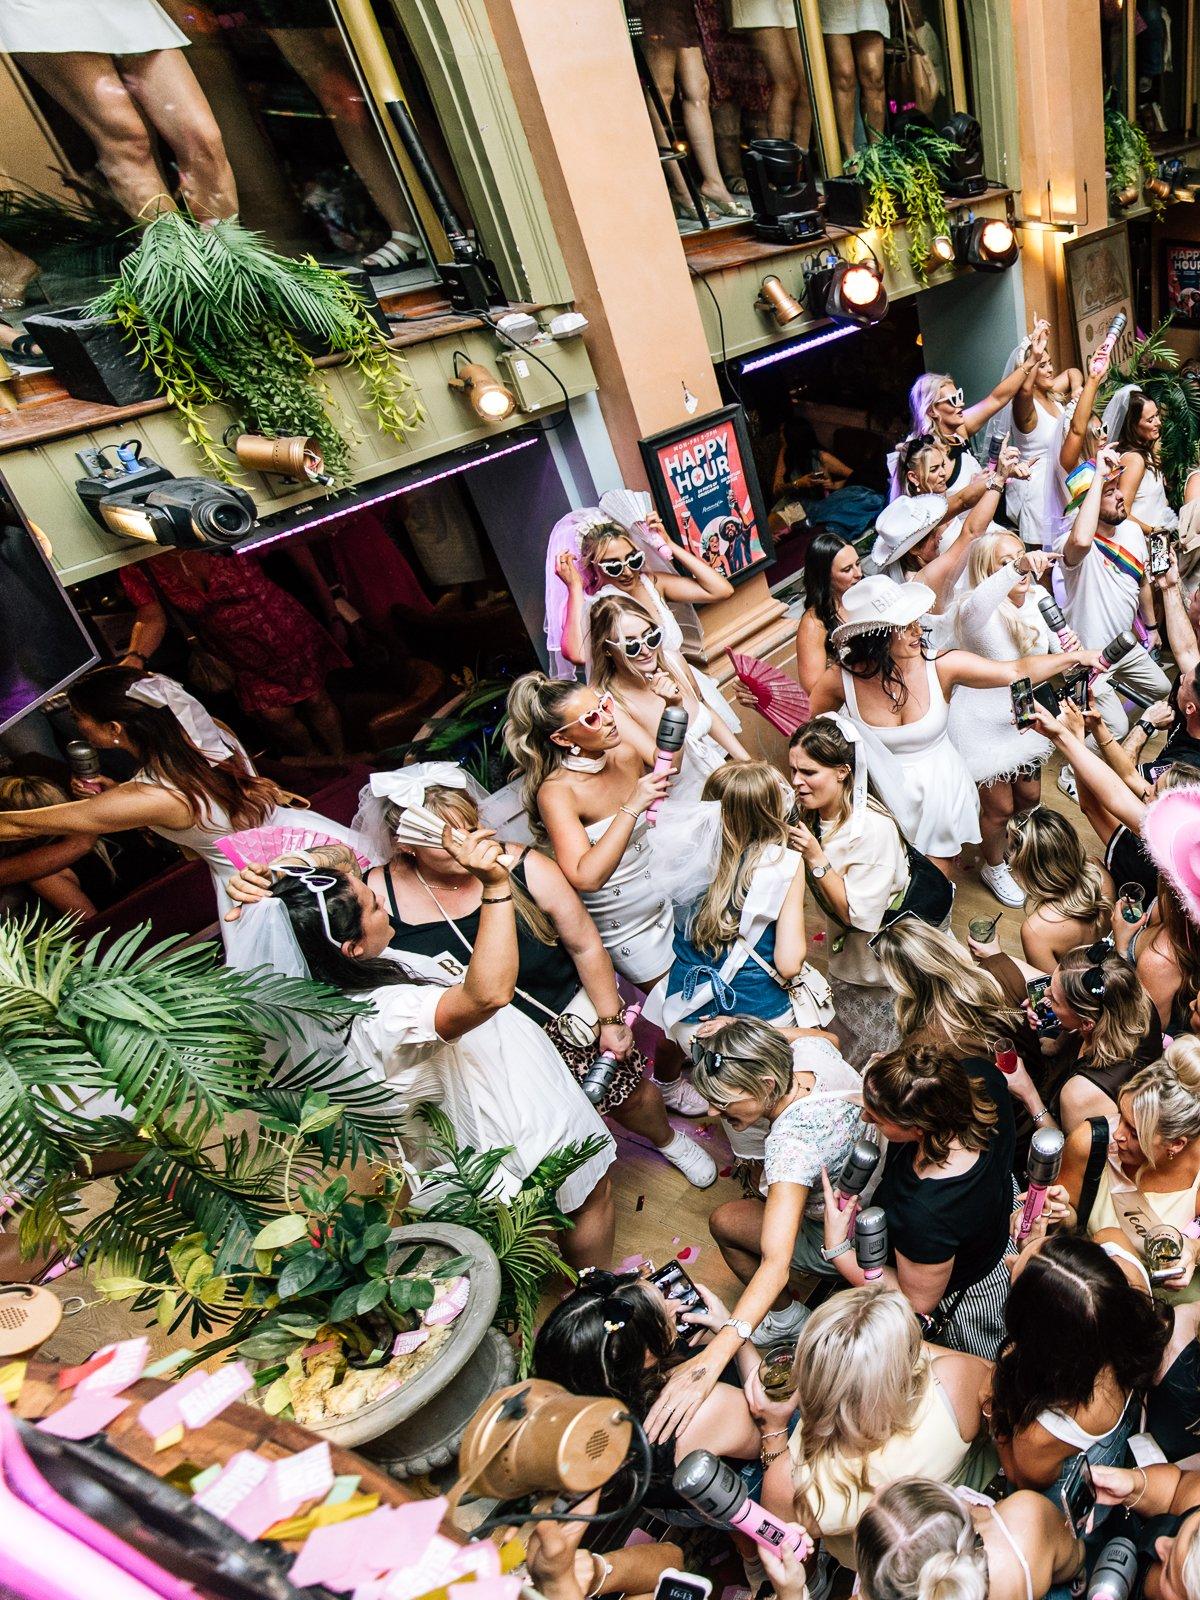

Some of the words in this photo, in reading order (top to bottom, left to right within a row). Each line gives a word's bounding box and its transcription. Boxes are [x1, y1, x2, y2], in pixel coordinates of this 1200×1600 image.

[664, 432, 728, 477] HAPPY
[675, 456, 730, 494] HOUR
[1123, 1206, 1152, 1238] Tea
